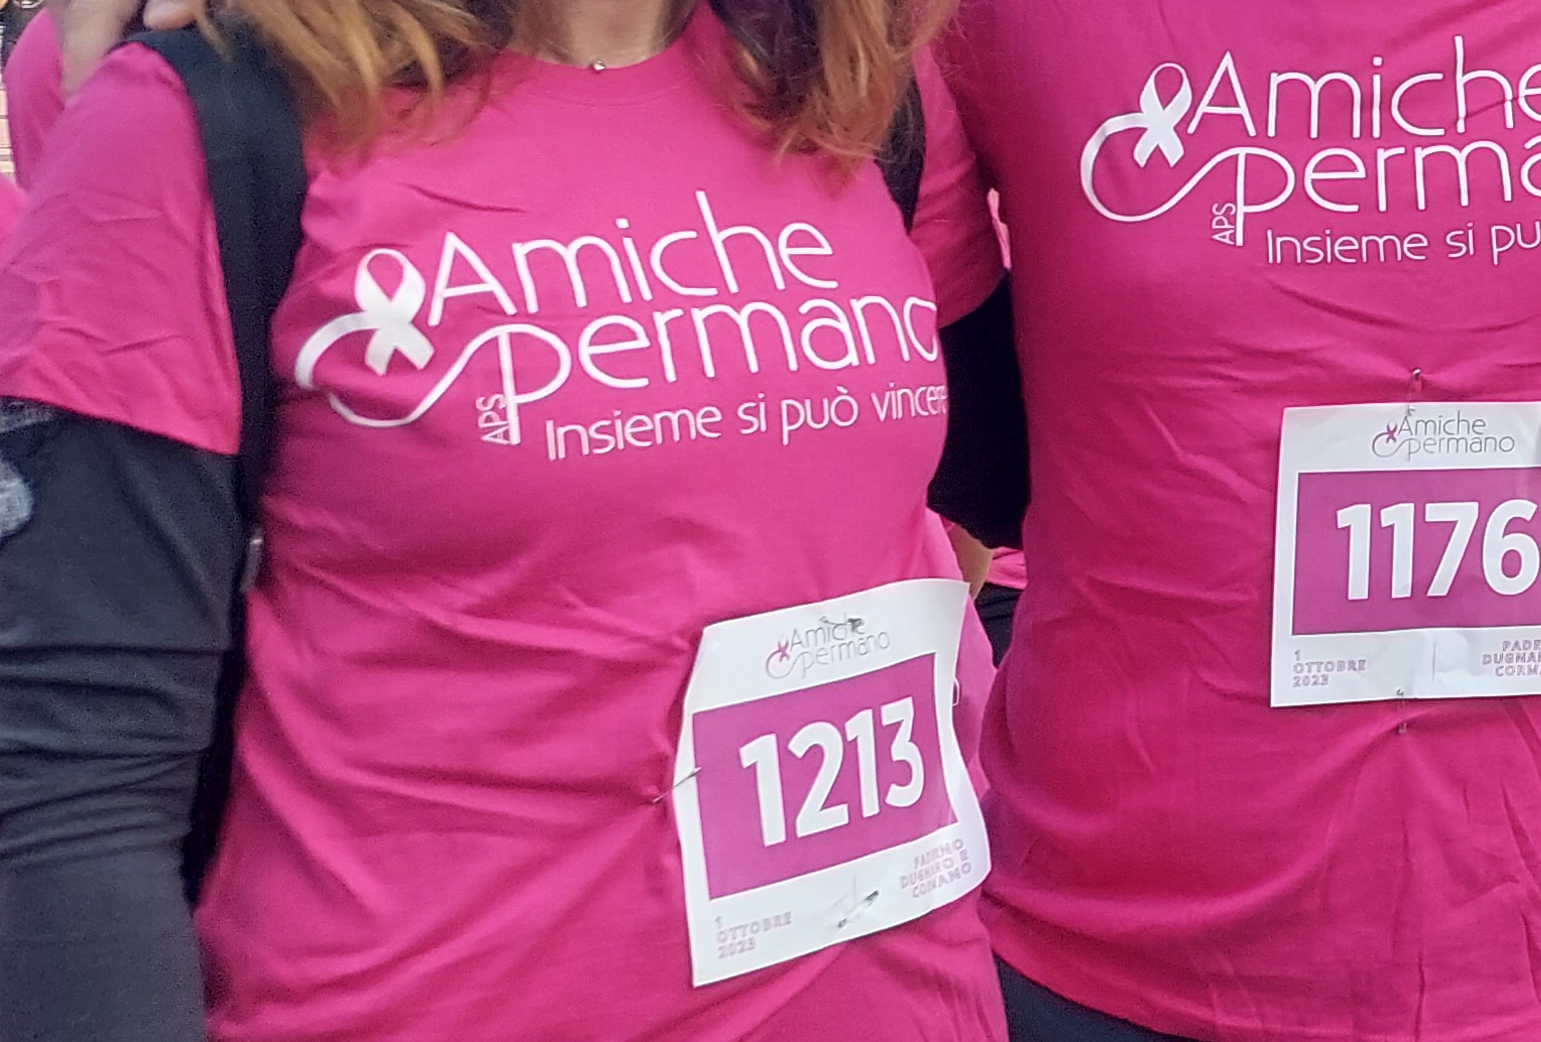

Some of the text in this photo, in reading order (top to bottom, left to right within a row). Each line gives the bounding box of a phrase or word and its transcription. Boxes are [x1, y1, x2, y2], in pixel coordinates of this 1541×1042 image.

[1210, 201, 1237, 246] APS
[1266, 227, 1429, 264] Insieme
[1445, 219, 1476, 258] si
[427, 190, 839, 326] Amiche
[475, 394, 511, 445] APS
[545, 405, 722, 461] Insieme
[737, 392, 767, 434] si
[780, 386, 859, 446] può
[1397, 409, 1486, 437] Amiche
[1336, 499, 1541, 600] 1176
[789, 612, 866, 650] Amiche
[1293, 659, 1366, 675] OTTOBRE
[739, 696, 925, 847] 1213
